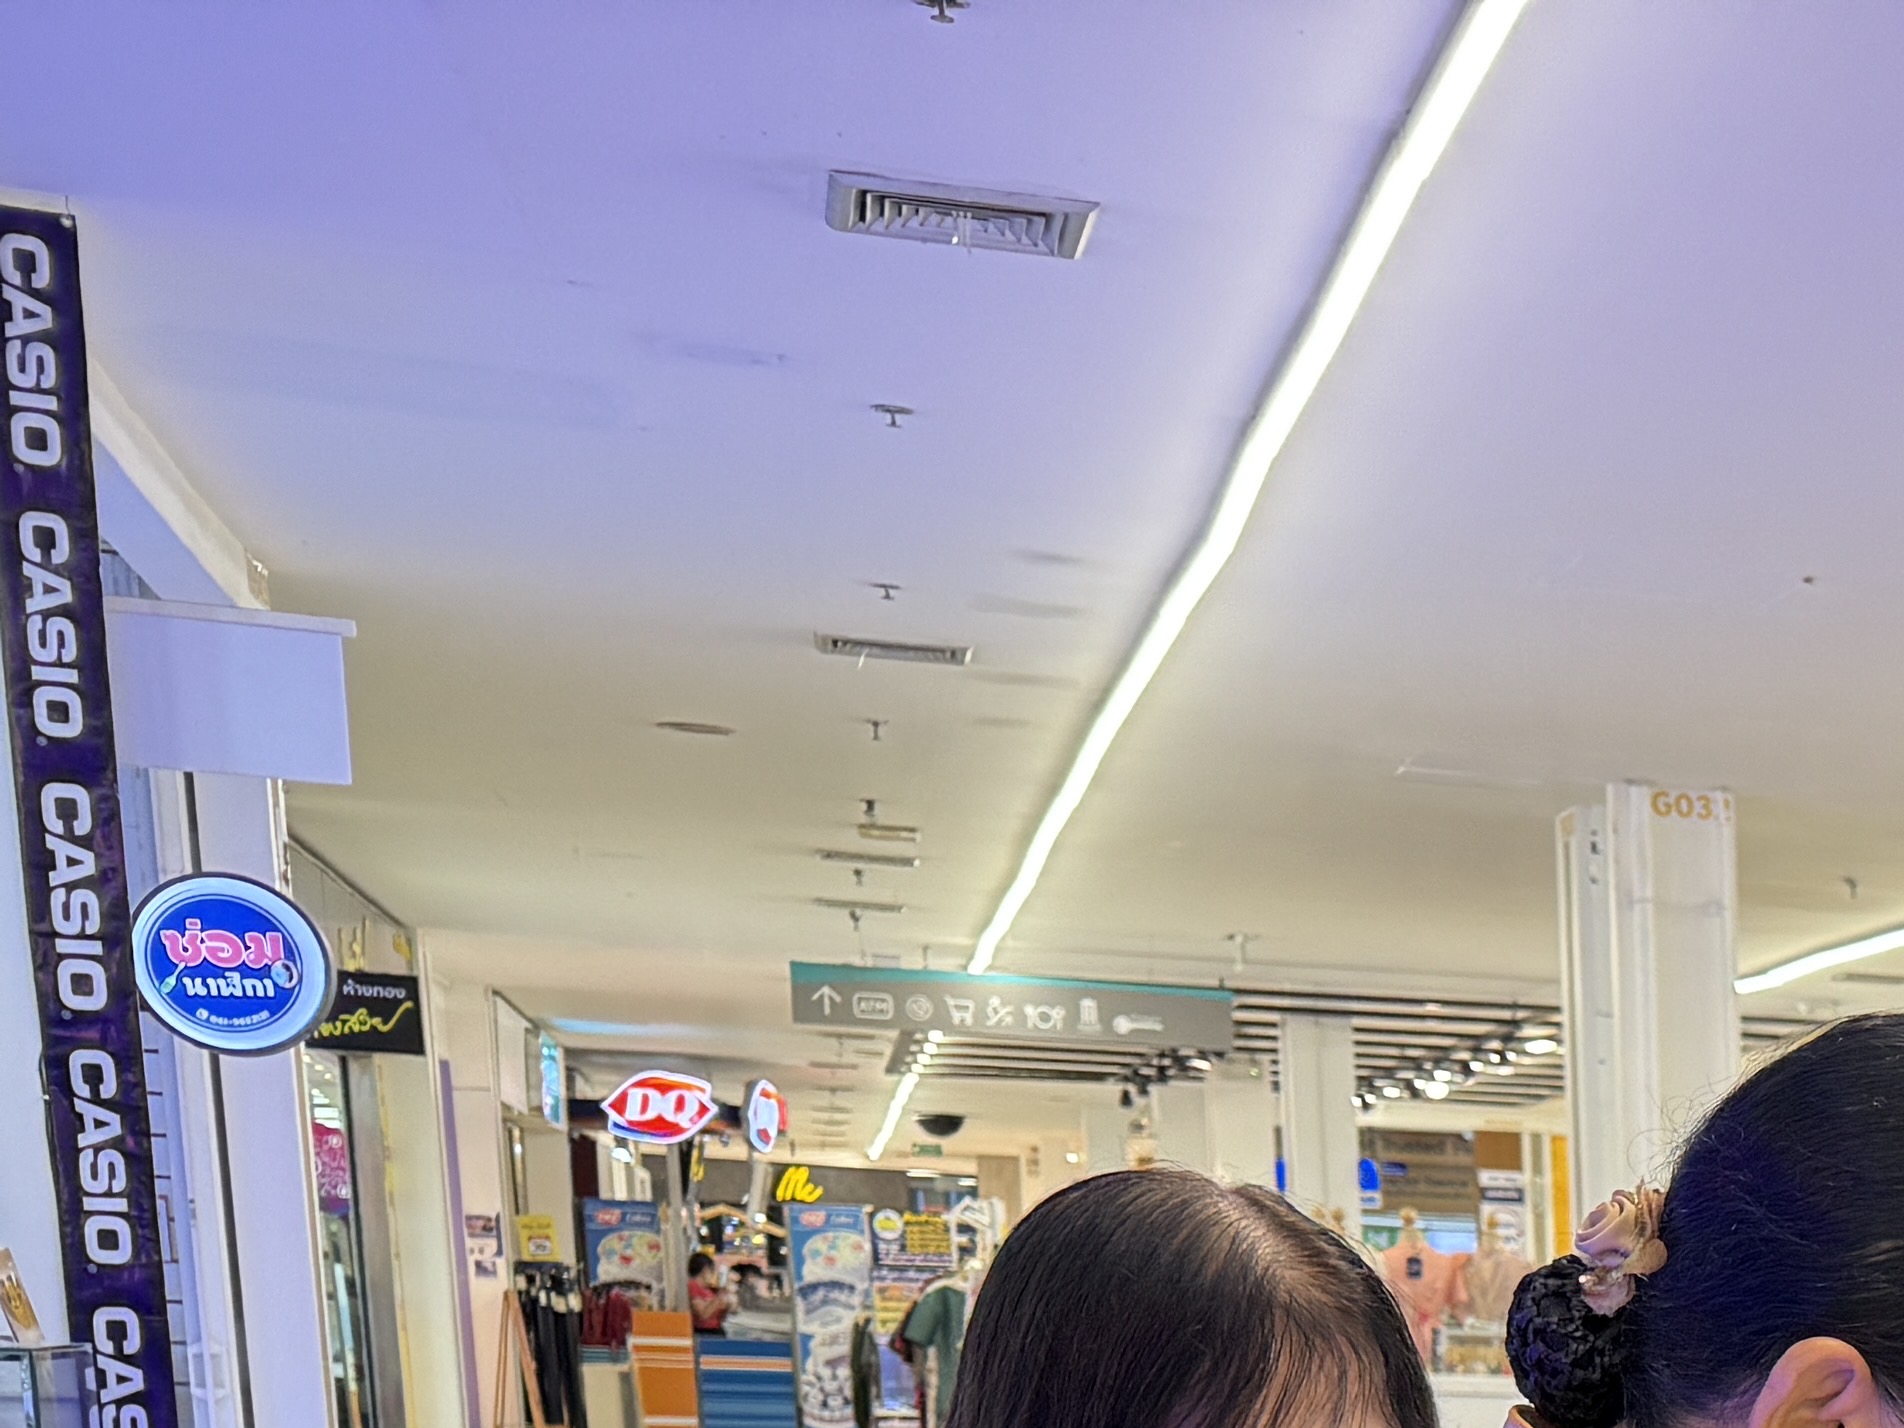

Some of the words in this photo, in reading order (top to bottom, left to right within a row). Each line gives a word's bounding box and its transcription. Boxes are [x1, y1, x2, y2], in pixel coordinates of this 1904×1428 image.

[0, 233, 63, 467] CASIO
[19, 511, 83, 739] CASIO
[41, 781, 108, 1011] CASIO
[160, 918, 283, 968] ซ่อม
[182, 971, 275, 998] นาฬิกา
[343, 979, 406, 999] ห้างทอง
[69, 1049, 132, 1266] CASIO
[625, 1088, 702, 1129] DQ
